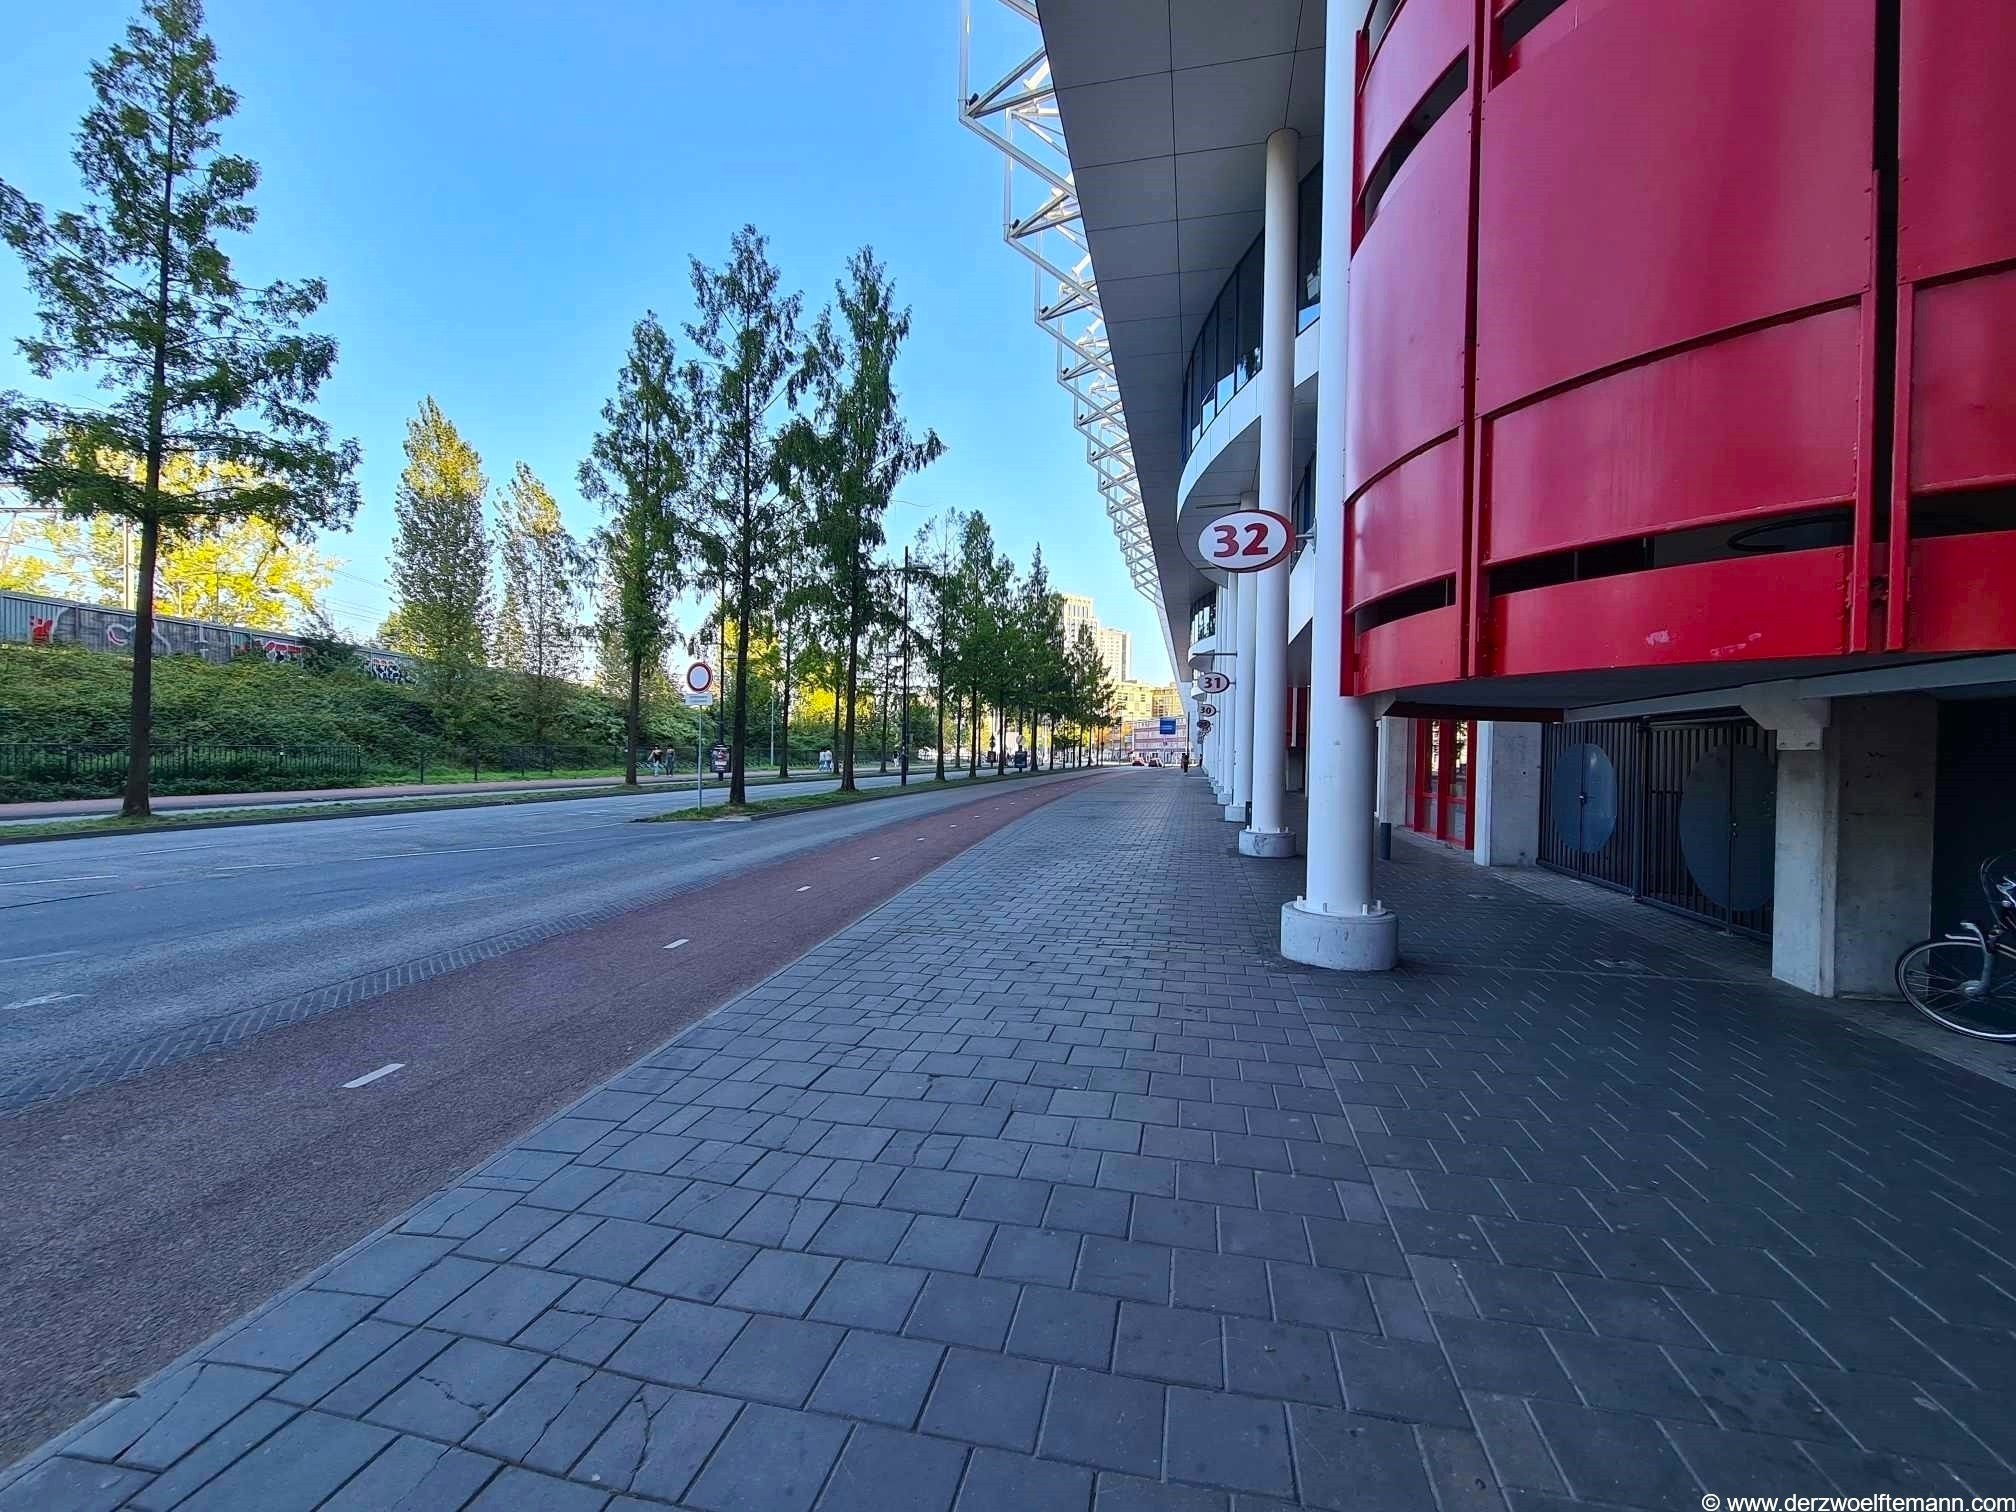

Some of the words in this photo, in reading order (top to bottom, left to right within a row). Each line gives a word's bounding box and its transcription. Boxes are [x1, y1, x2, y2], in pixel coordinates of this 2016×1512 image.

[1213, 522, 1269, 557] 32
[1204, 677, 1221, 689] 31
[1200, 706, 1212, 715] 30
